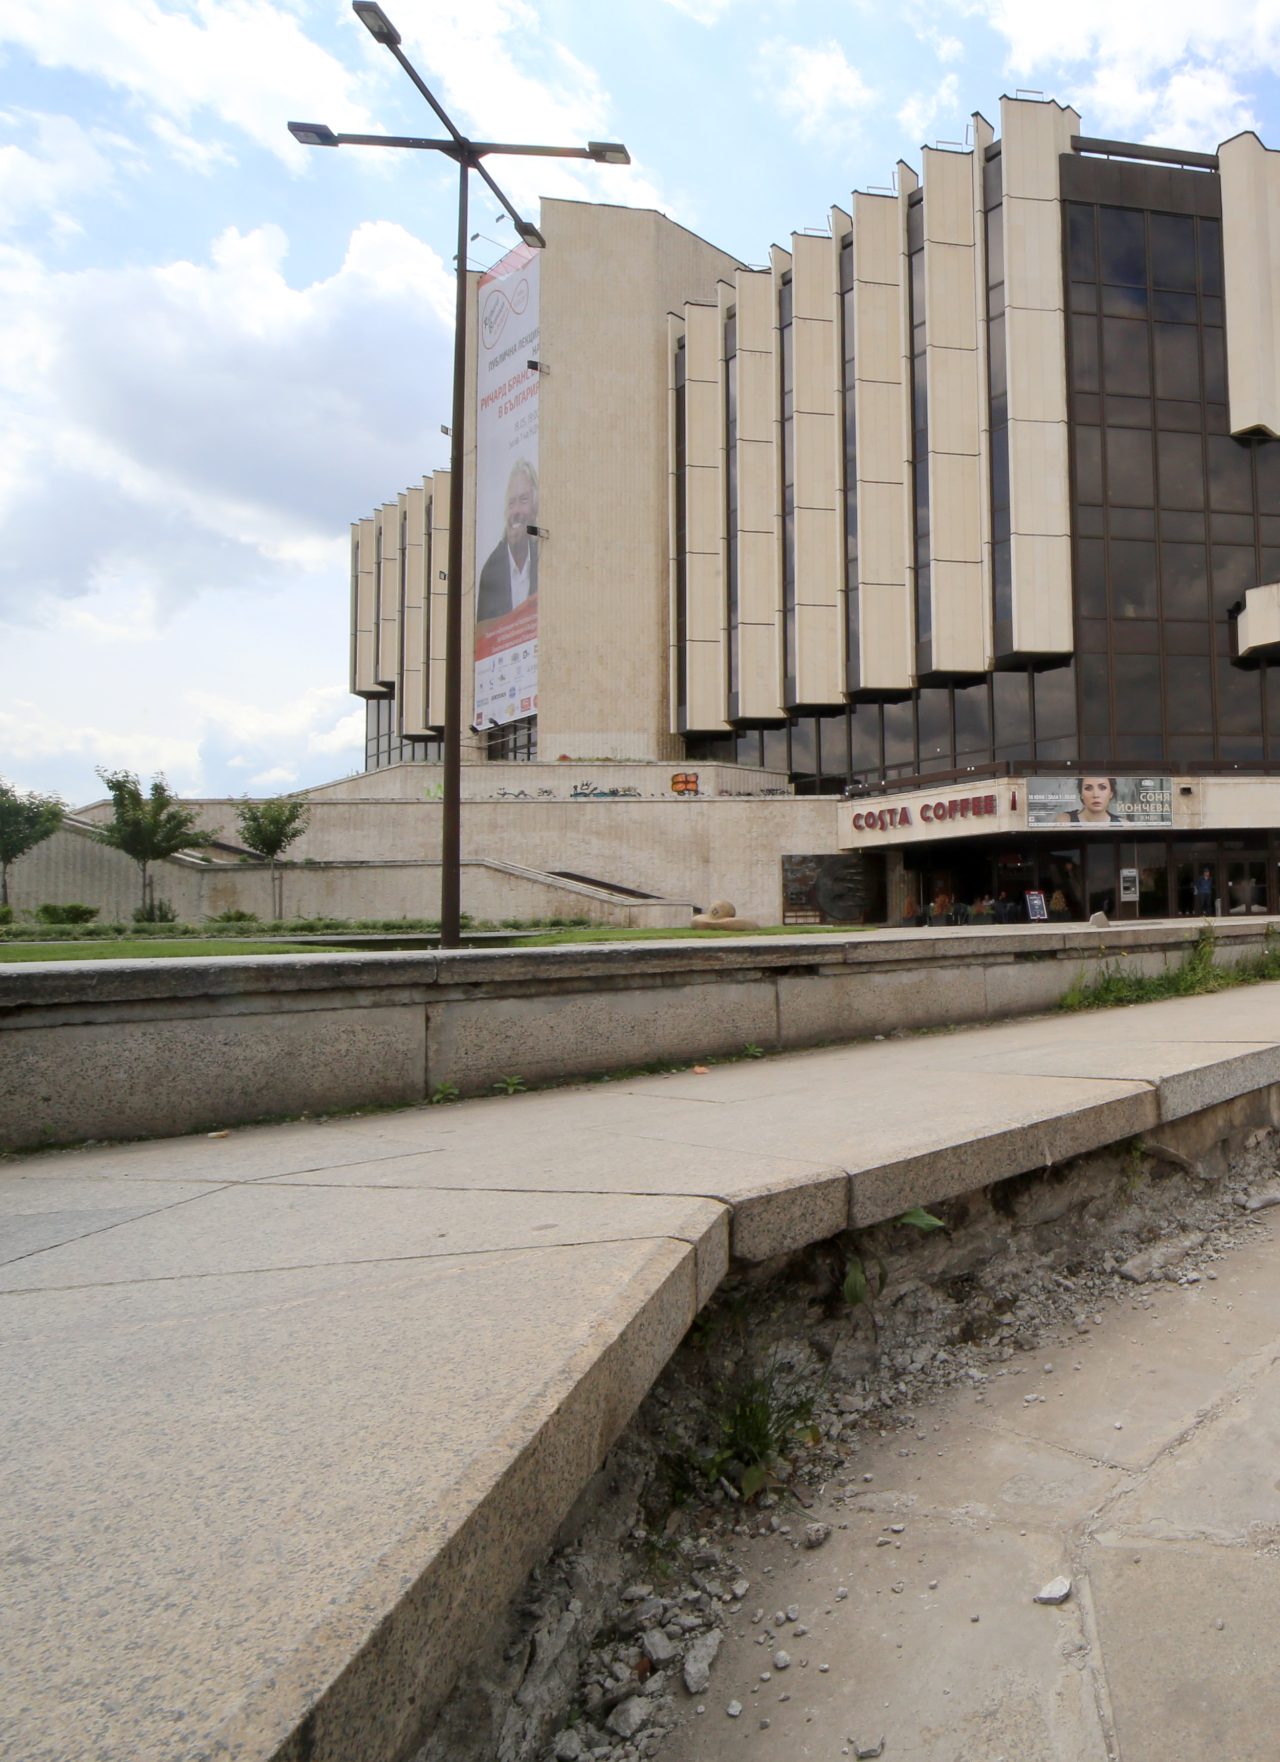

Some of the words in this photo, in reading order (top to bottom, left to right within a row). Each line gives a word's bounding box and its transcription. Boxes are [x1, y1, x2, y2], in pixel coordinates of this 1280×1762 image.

[1139, 792, 1170, 802] СОНЯ
[852, 806, 912, 832] COSTA
[919, 794, 997, 823] COFFEE
[1116, 801, 1171, 813] ЙОНЧЕВА
